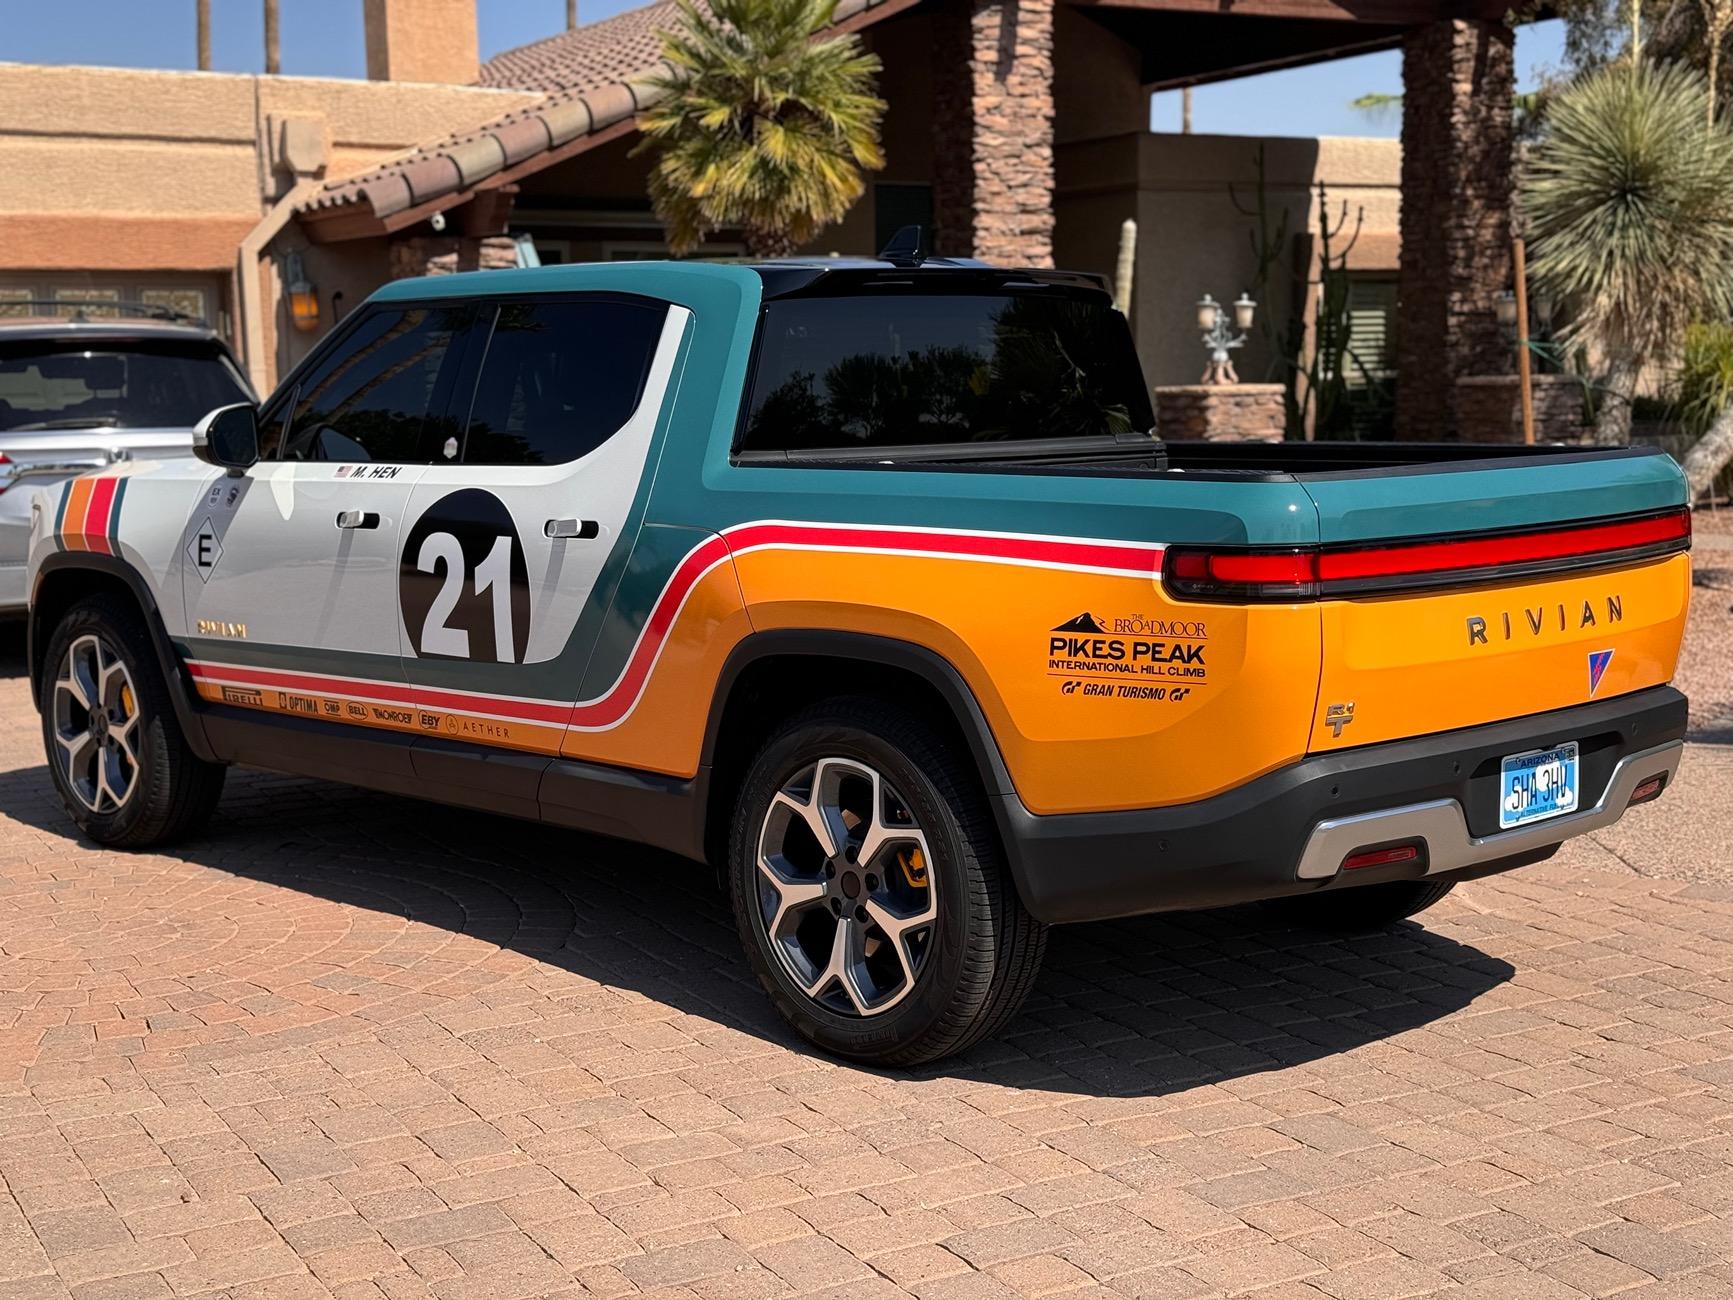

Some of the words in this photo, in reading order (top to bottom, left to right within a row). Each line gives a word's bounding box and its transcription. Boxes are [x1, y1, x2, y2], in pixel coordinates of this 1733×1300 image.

[350, 466, 366, 478] M.
[368, 466, 403, 479] HEN
[198, 534, 213, 567] E
[417, 532, 515, 664] 21
[1131, 613, 1145, 621] THE
[1466, 595, 1624, 646] RIVIAN
[1113, 618, 1208, 637] BROADMOOR
[1049, 637, 1126, 660] PIKES
[1132, 641, 1206, 665] PEAK
[1048, 659, 1138, 674] INTERNATIONAL
[1140, 665, 1166, 676] HILL
[1167, 666, 1206, 678] CLIMB
[221, 685, 264, 706] PIRELLI
[1083, 683, 1115, 697] GRAN
[1117, 685, 1167, 700] TURISMO
[288, 696, 319, 714] OPTIMA
[323, 702, 341, 714] OMP
[348, 704, 367, 717] BELL
[421, 714, 441, 728] EBY
[463, 721, 510, 739] AETHER
[1520, 752, 1561, 768] ARIZONA
[1511, 771, 1538, 810] SHA
[1542, 764, 1568, 802] 3HV
